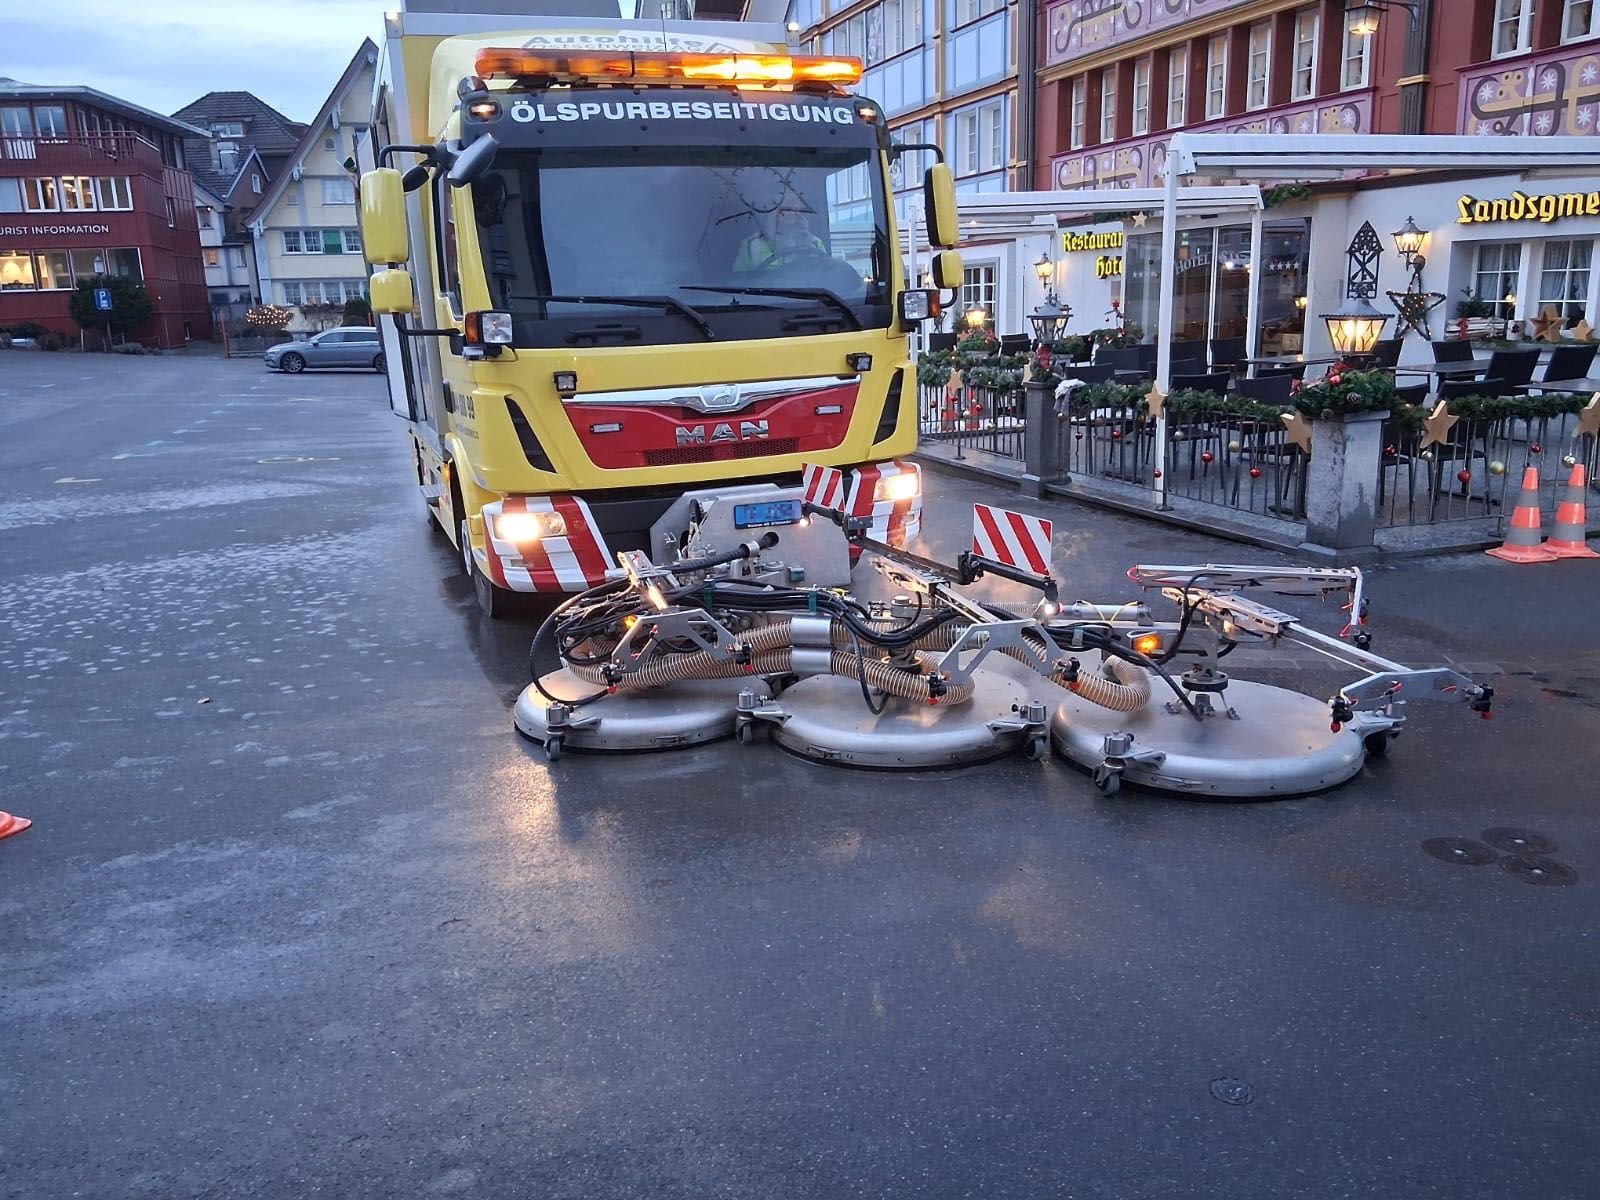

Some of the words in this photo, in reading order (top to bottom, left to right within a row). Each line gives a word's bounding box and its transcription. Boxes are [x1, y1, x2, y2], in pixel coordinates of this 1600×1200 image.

[510, 101, 854, 125] ÖLSPURBESEITIGUNG
[31, 224, 109, 234] INFORMATION
[99, 290, 106, 301] P
[675, 419, 769, 447] MAN
